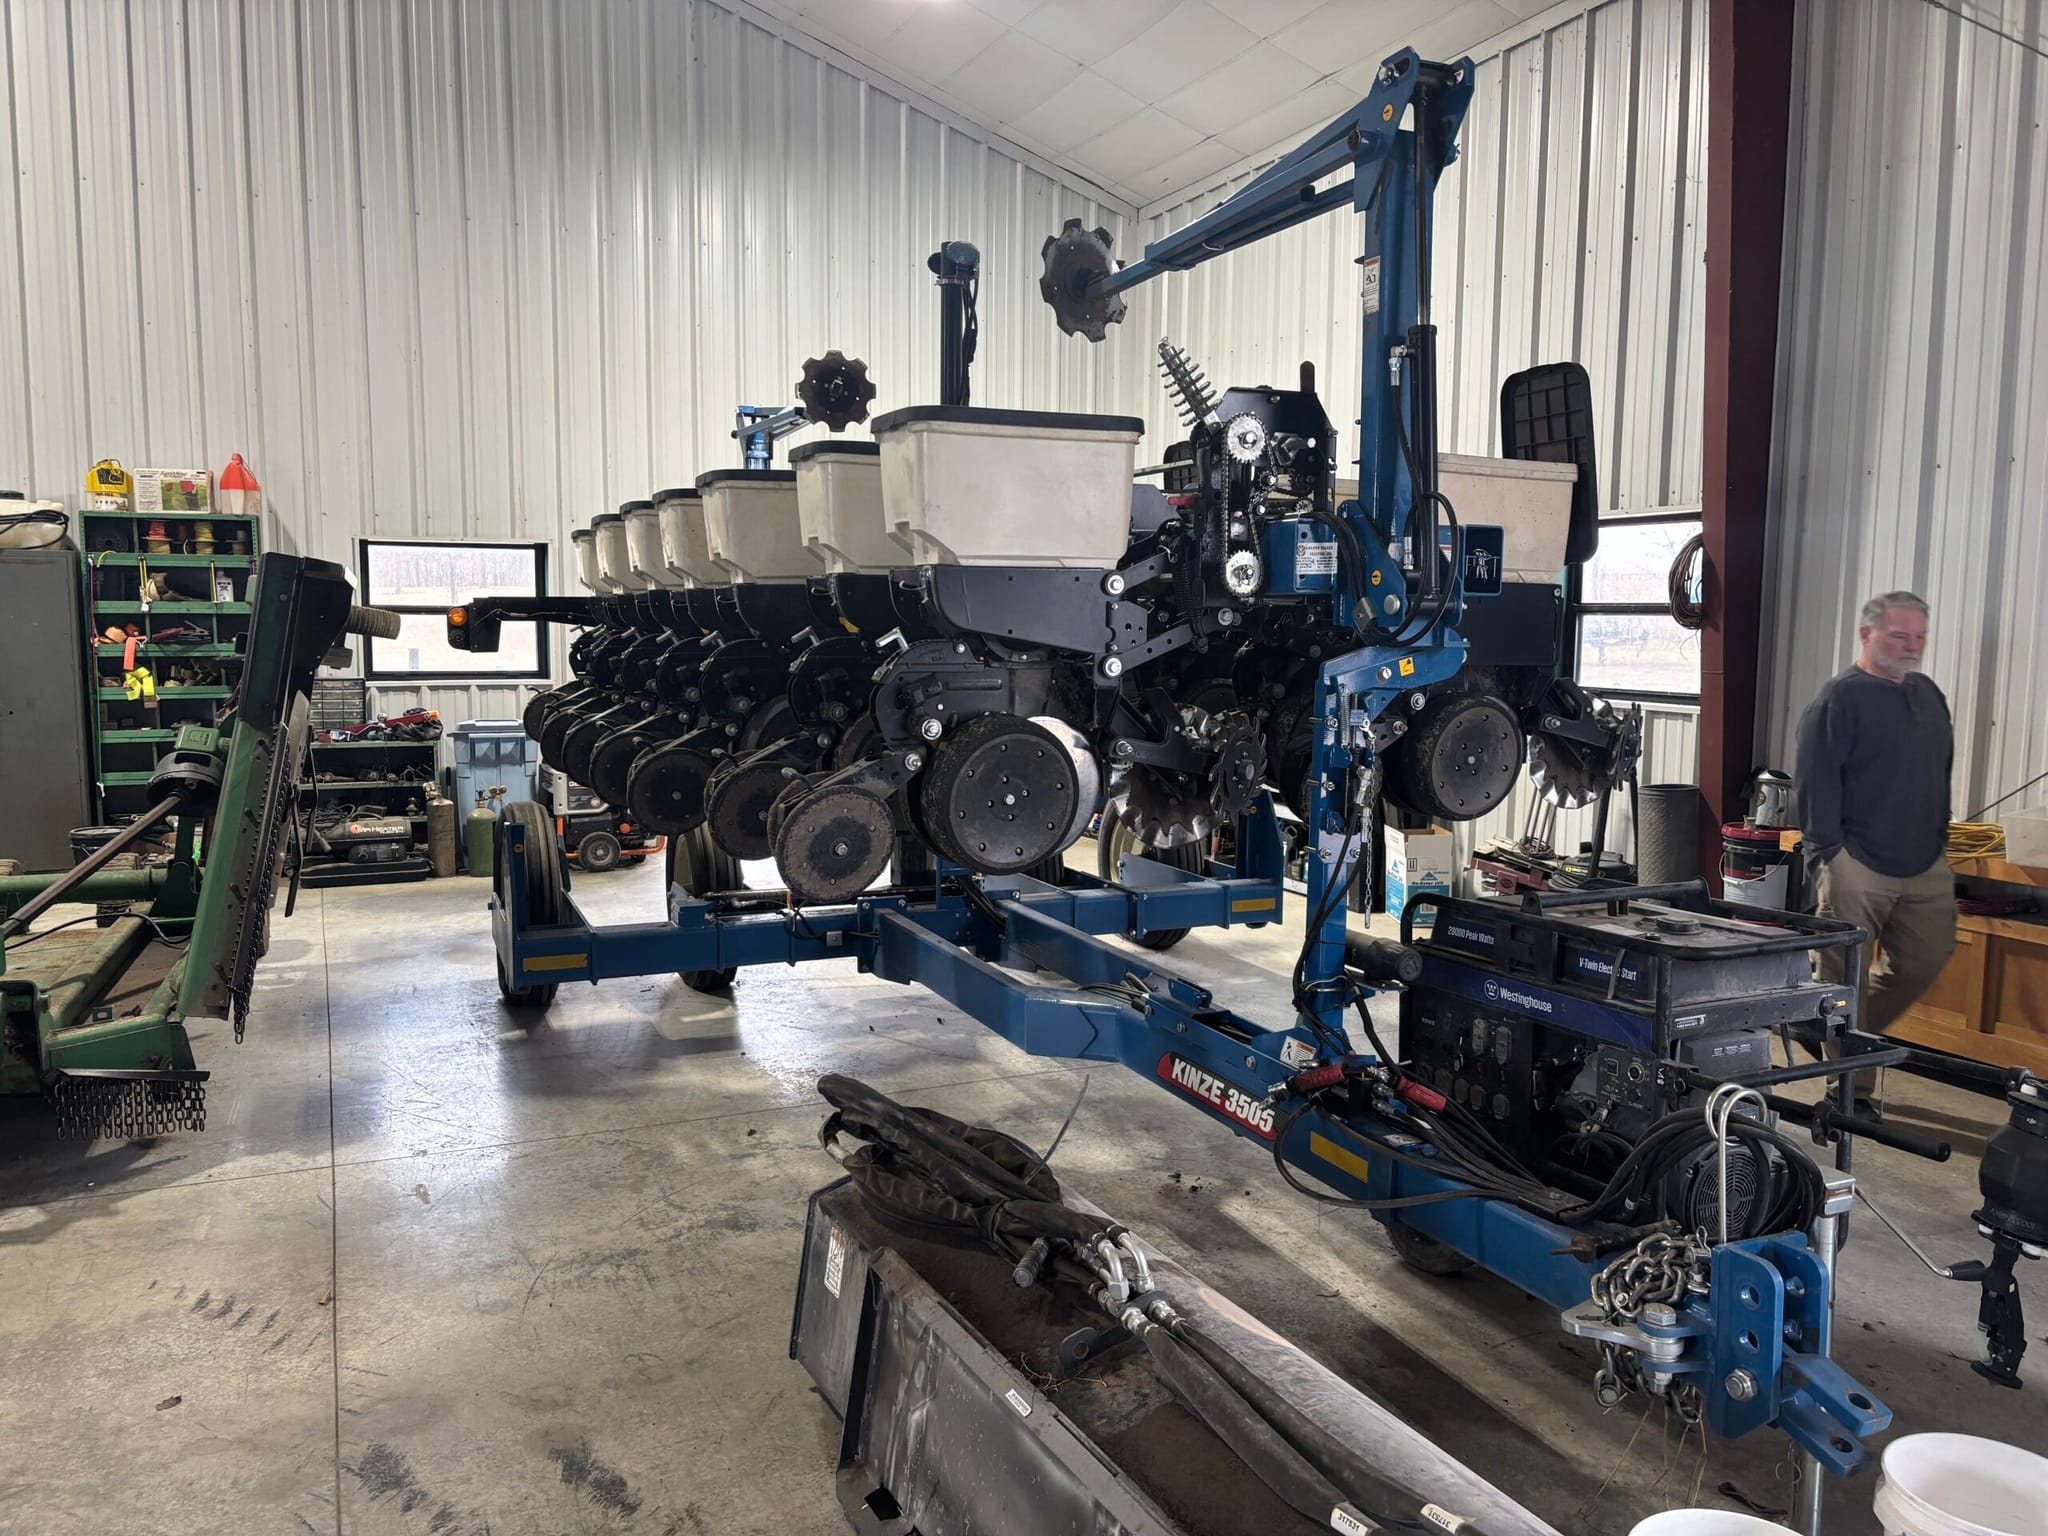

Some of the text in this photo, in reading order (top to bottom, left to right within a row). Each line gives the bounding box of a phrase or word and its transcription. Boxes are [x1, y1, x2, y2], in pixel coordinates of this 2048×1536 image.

[1447, 925, 1495, 945] 28000 Peak Watts
[1579, 957, 1598, 971] V-Twin
[1621, 967, 1637, 981] Start
[1500, 987, 1552, 1013] Westinghouse
[1171, 1058, 1276, 1133] KINZE 3505
[1337, 1513, 1361, 1532] 317531
[1428, 1509, 1452, 1528] 317531
